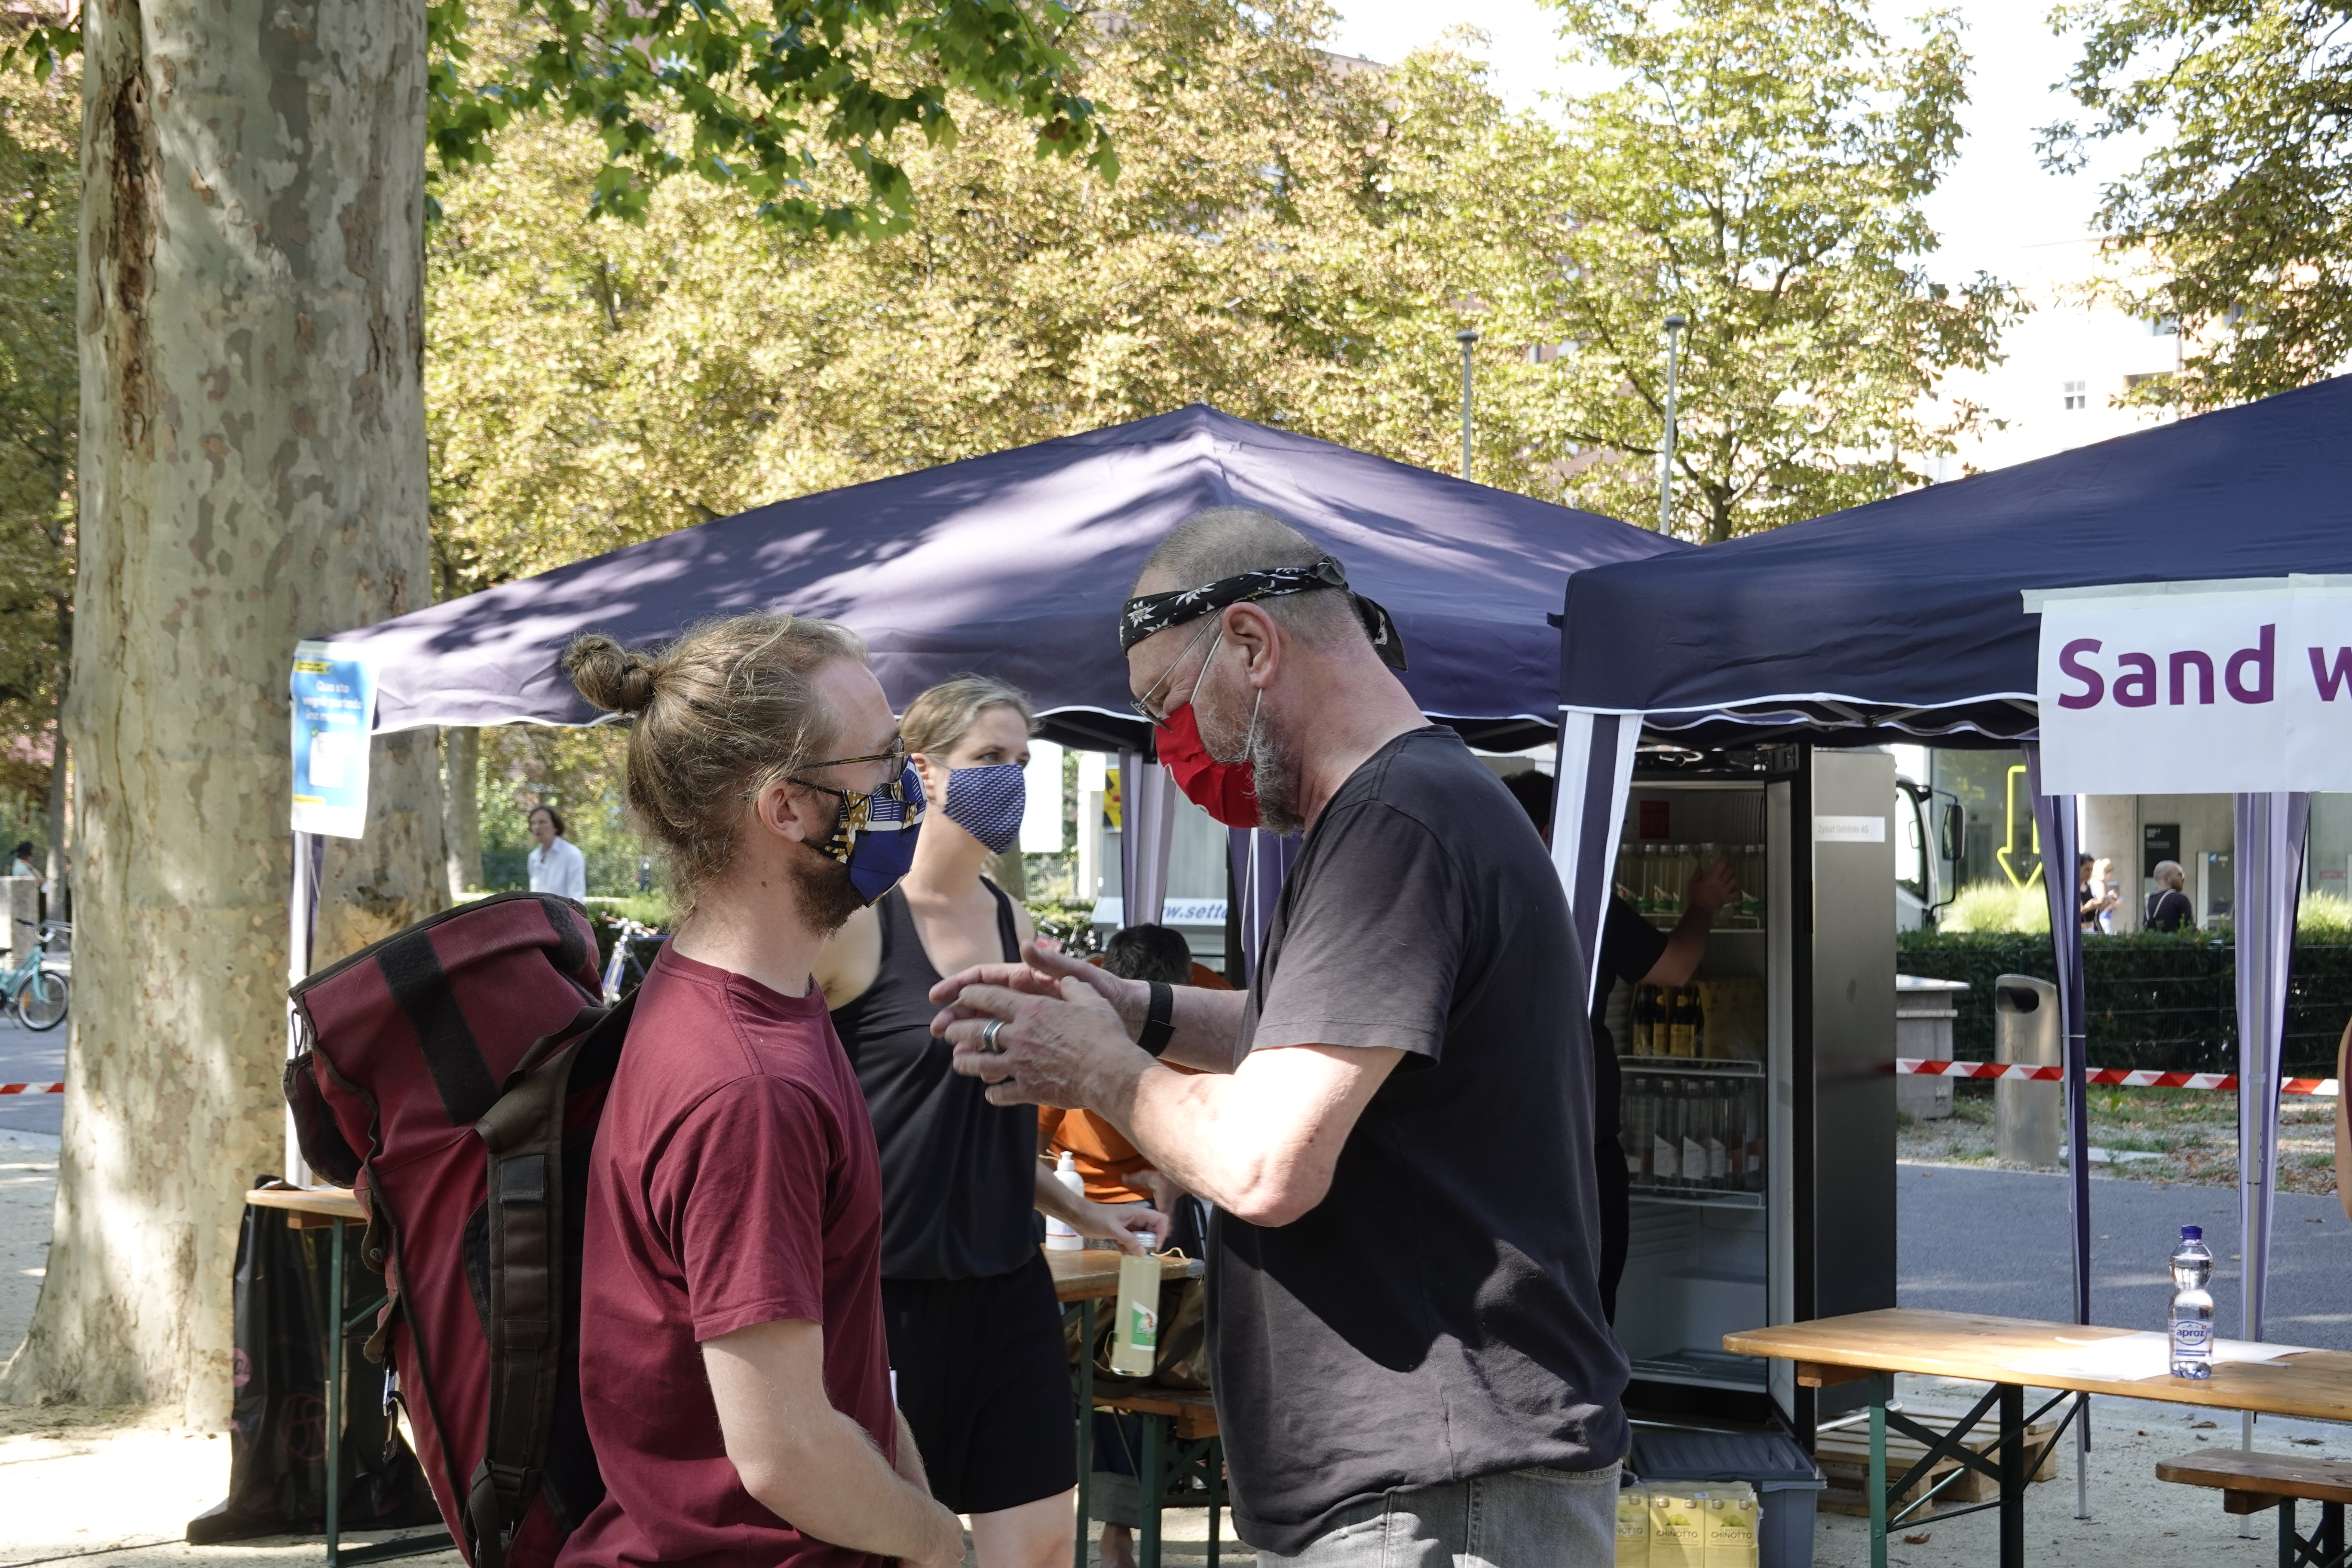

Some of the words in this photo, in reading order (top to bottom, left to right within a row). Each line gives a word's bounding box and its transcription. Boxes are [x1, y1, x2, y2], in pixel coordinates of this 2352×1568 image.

[2058, 623, 2275, 710] Sand
[1836, 824, 1859, 833] Getränke
[1861, 824, 1868, 833] AG
[1164, 903, 1228, 918] w.sett
[2177, 1329, 2204, 1338] aproz
[1711, 1531, 1752, 1539] CHINOTTO
